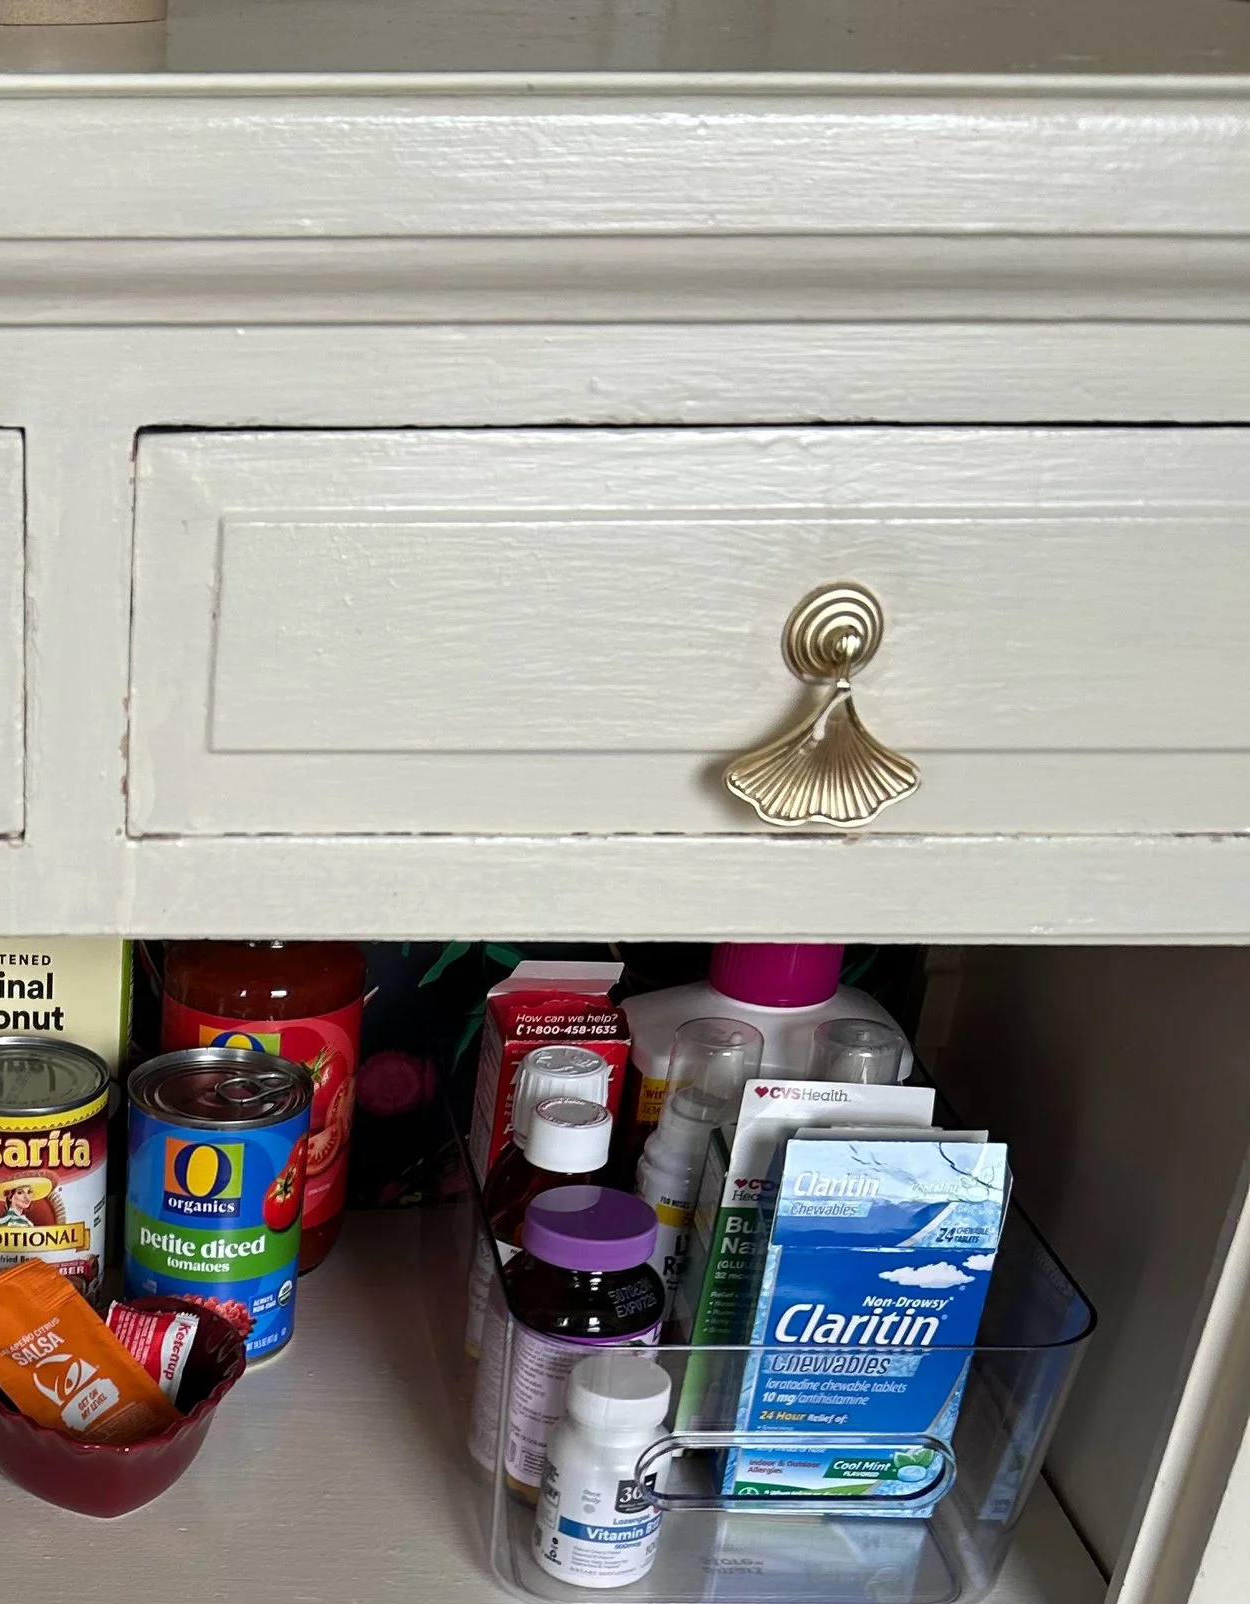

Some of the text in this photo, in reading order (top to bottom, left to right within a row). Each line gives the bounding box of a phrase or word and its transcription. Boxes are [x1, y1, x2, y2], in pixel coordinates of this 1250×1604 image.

[516, 1013, 540, 1023] How
[544, 1014, 564, 1022] can
[586, 1013, 618, 1025] help?
[526, 1025, 617, 1034] 1-800-458-1635
[793, 1171, 881, 1198] Claritin
[168, 1197, 235, 1214] organics
[790, 1202, 857, 1216] Chewables
[140, 1227, 266, 1259] petite diced
[935, 1228, 954, 1243] 24
[167, 1256, 230, 1273] tomatoes
[862, 1296, 948, 1311] Non-Drowsy
[775, 1303, 940, 1346] Claritin
[12, 1331, 65, 1365] SALSA
[770, 1354, 891, 1375] Chewables
[765, 1378, 907, 1393] loratadine chewable tablets
[762, 1393, 776, 1402] 10
[759, 1411, 774, 1420] 24
[776, 1412, 806, 1421] Hour
[807, 1413, 832, 1423] Relief
[833, 1460, 892, 1472] Cool Mint
[587, 1526, 643, 1542] Vitamin
